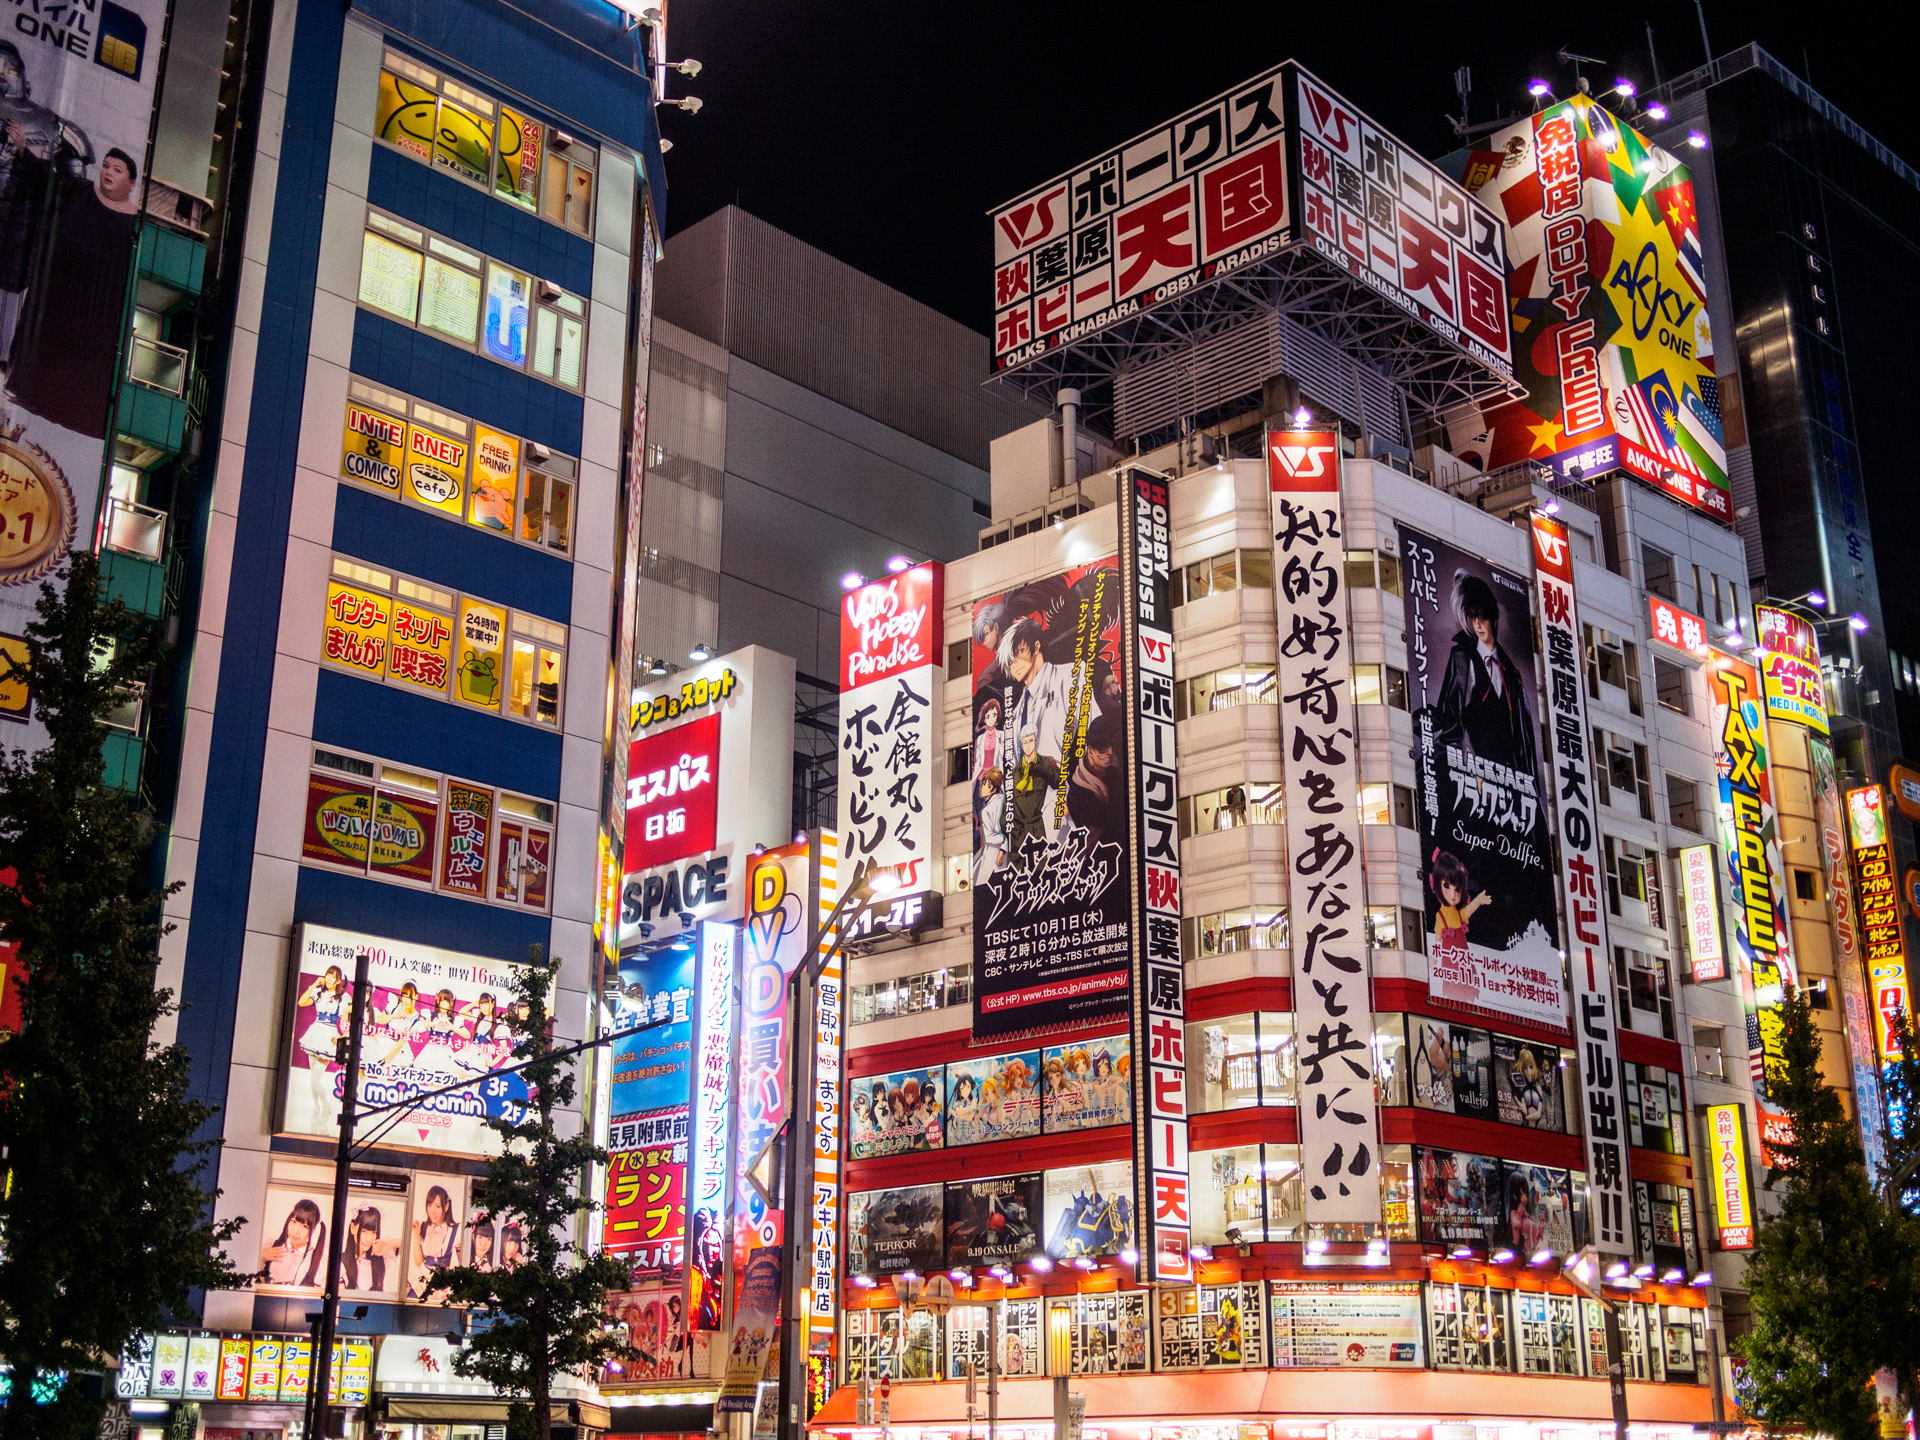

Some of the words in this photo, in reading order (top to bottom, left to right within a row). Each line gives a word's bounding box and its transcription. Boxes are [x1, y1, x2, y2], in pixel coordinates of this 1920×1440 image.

[16, 13, 89, 60] ONE
[1073, 80, 1282, 223] ボークス
[1536, 114, 1581, 217] 免税店
[1301, 136, 1396, 236] 秋葉原
[1364, 129, 1501, 270] ボークス
[997, 220, 1110, 306] 秋葉原
[1547, 216, 1592, 321] DUTY
[997, 339, 1045, 371] VOLKS
[1050, 300, 1139, 349] AKIHABARA
[1142, 269, 1200, 309] HOBBY
[1204, 231, 1291, 280] PARADISE
[1308, 232, 1348, 267] VOLKS
[1351, 260, 1420, 318] AKIHABARA
[1420, 307, 1461, 341] HOBBY
[1461, 334, 1513, 378] PARADISE
[1609, 257, 1695, 329] AKKY
[1659, 327, 1692, 361] ONE
[1556, 318, 1604, 436] FREE
[365, 440, 381, 460] &
[479, 454, 512, 475] DRINK!
[481, 442, 510, 461] FREE
[1627, 448, 1661, 477] AKKY
[345, 452, 400, 490] COMICS
[414, 479, 447, 498] cafe
[1152, 478, 1170, 582] HOBBY
[1136, 478, 1155, 622] PARADISE
[465, 612, 500, 634] 24時間
[465, 626, 499, 647] 営業中!
[1656, 605, 1703, 650] 免税
[848, 636, 925, 687] Paradise
[1769, 696, 1801, 714] MEDIA
[1717, 670, 1761, 793] TAX
[884, 678, 930, 852] 全館丸々
[627, 753, 710, 810] エスパス
[322, 809, 423, 849] WELCOME
[645, 807, 686, 842] 日拓
[1452, 820, 1495, 852] Super
[332, 837, 366, 853] ウェルカム
[374, 846, 404, 860] AKIBA
[449, 812, 485, 878] ウェルカム
[1858, 846, 1887, 863] ゲーム
[1731, 786, 1779, 955] FREE
[1862, 861, 1887, 878] CD
[448, 878, 478, 893] AKIBA
[622, 855, 728, 925] SPACE
[1861, 877, 1892, 895] アイドル
[1688, 850, 1714, 955] 愛客旺免税店
[1863, 894, 1894, 911] アニメ
[1865, 909, 1895, 926] コミック
[1869, 927, 1897, 942] ホビー
[1869, 942, 1900, 959] フィギュア
[1694, 960, 1720, 972] AKKY
[1697, 968, 1720, 979] ONE
[1022, 973, 1128, 1002] www.tbs.co.jp/anime/ybj/
[819, 982, 838, 1047] 買取り
[818, 1054, 838, 1069] MUX
[486, 1078, 509, 1098] 3F
[1459, 1090, 1489, 1109] vallejo
[1497, 1090, 1511, 1103] 9.19
[500, 1100, 521, 1121] 2F
[1716, 1109, 1734, 1137] 免税
[1719, 1139, 1738, 1176] TAX
[1724, 1176, 1744, 1225] FREE
[873, 1239, 917, 1253] TERROR
[1722, 1227, 1750, 1238] AKKY
[1726, 1236, 1749, 1247] ONE
[815, 1186, 831, 1313] アキバ駅前店
[967, 1246, 983, 1257] 9.19
[983, 1245, 996, 1256] ON
[996, 1243, 1021, 1255] SALE
[1160, 1291, 1196, 1316] 3F
[1519, 1298, 1545, 1321] 5F
[1161, 1317, 1199, 1341] 食玩
[1021, 1327, 1038, 1375] 雑貨
[1681, 1353, 1691, 1363] OK
